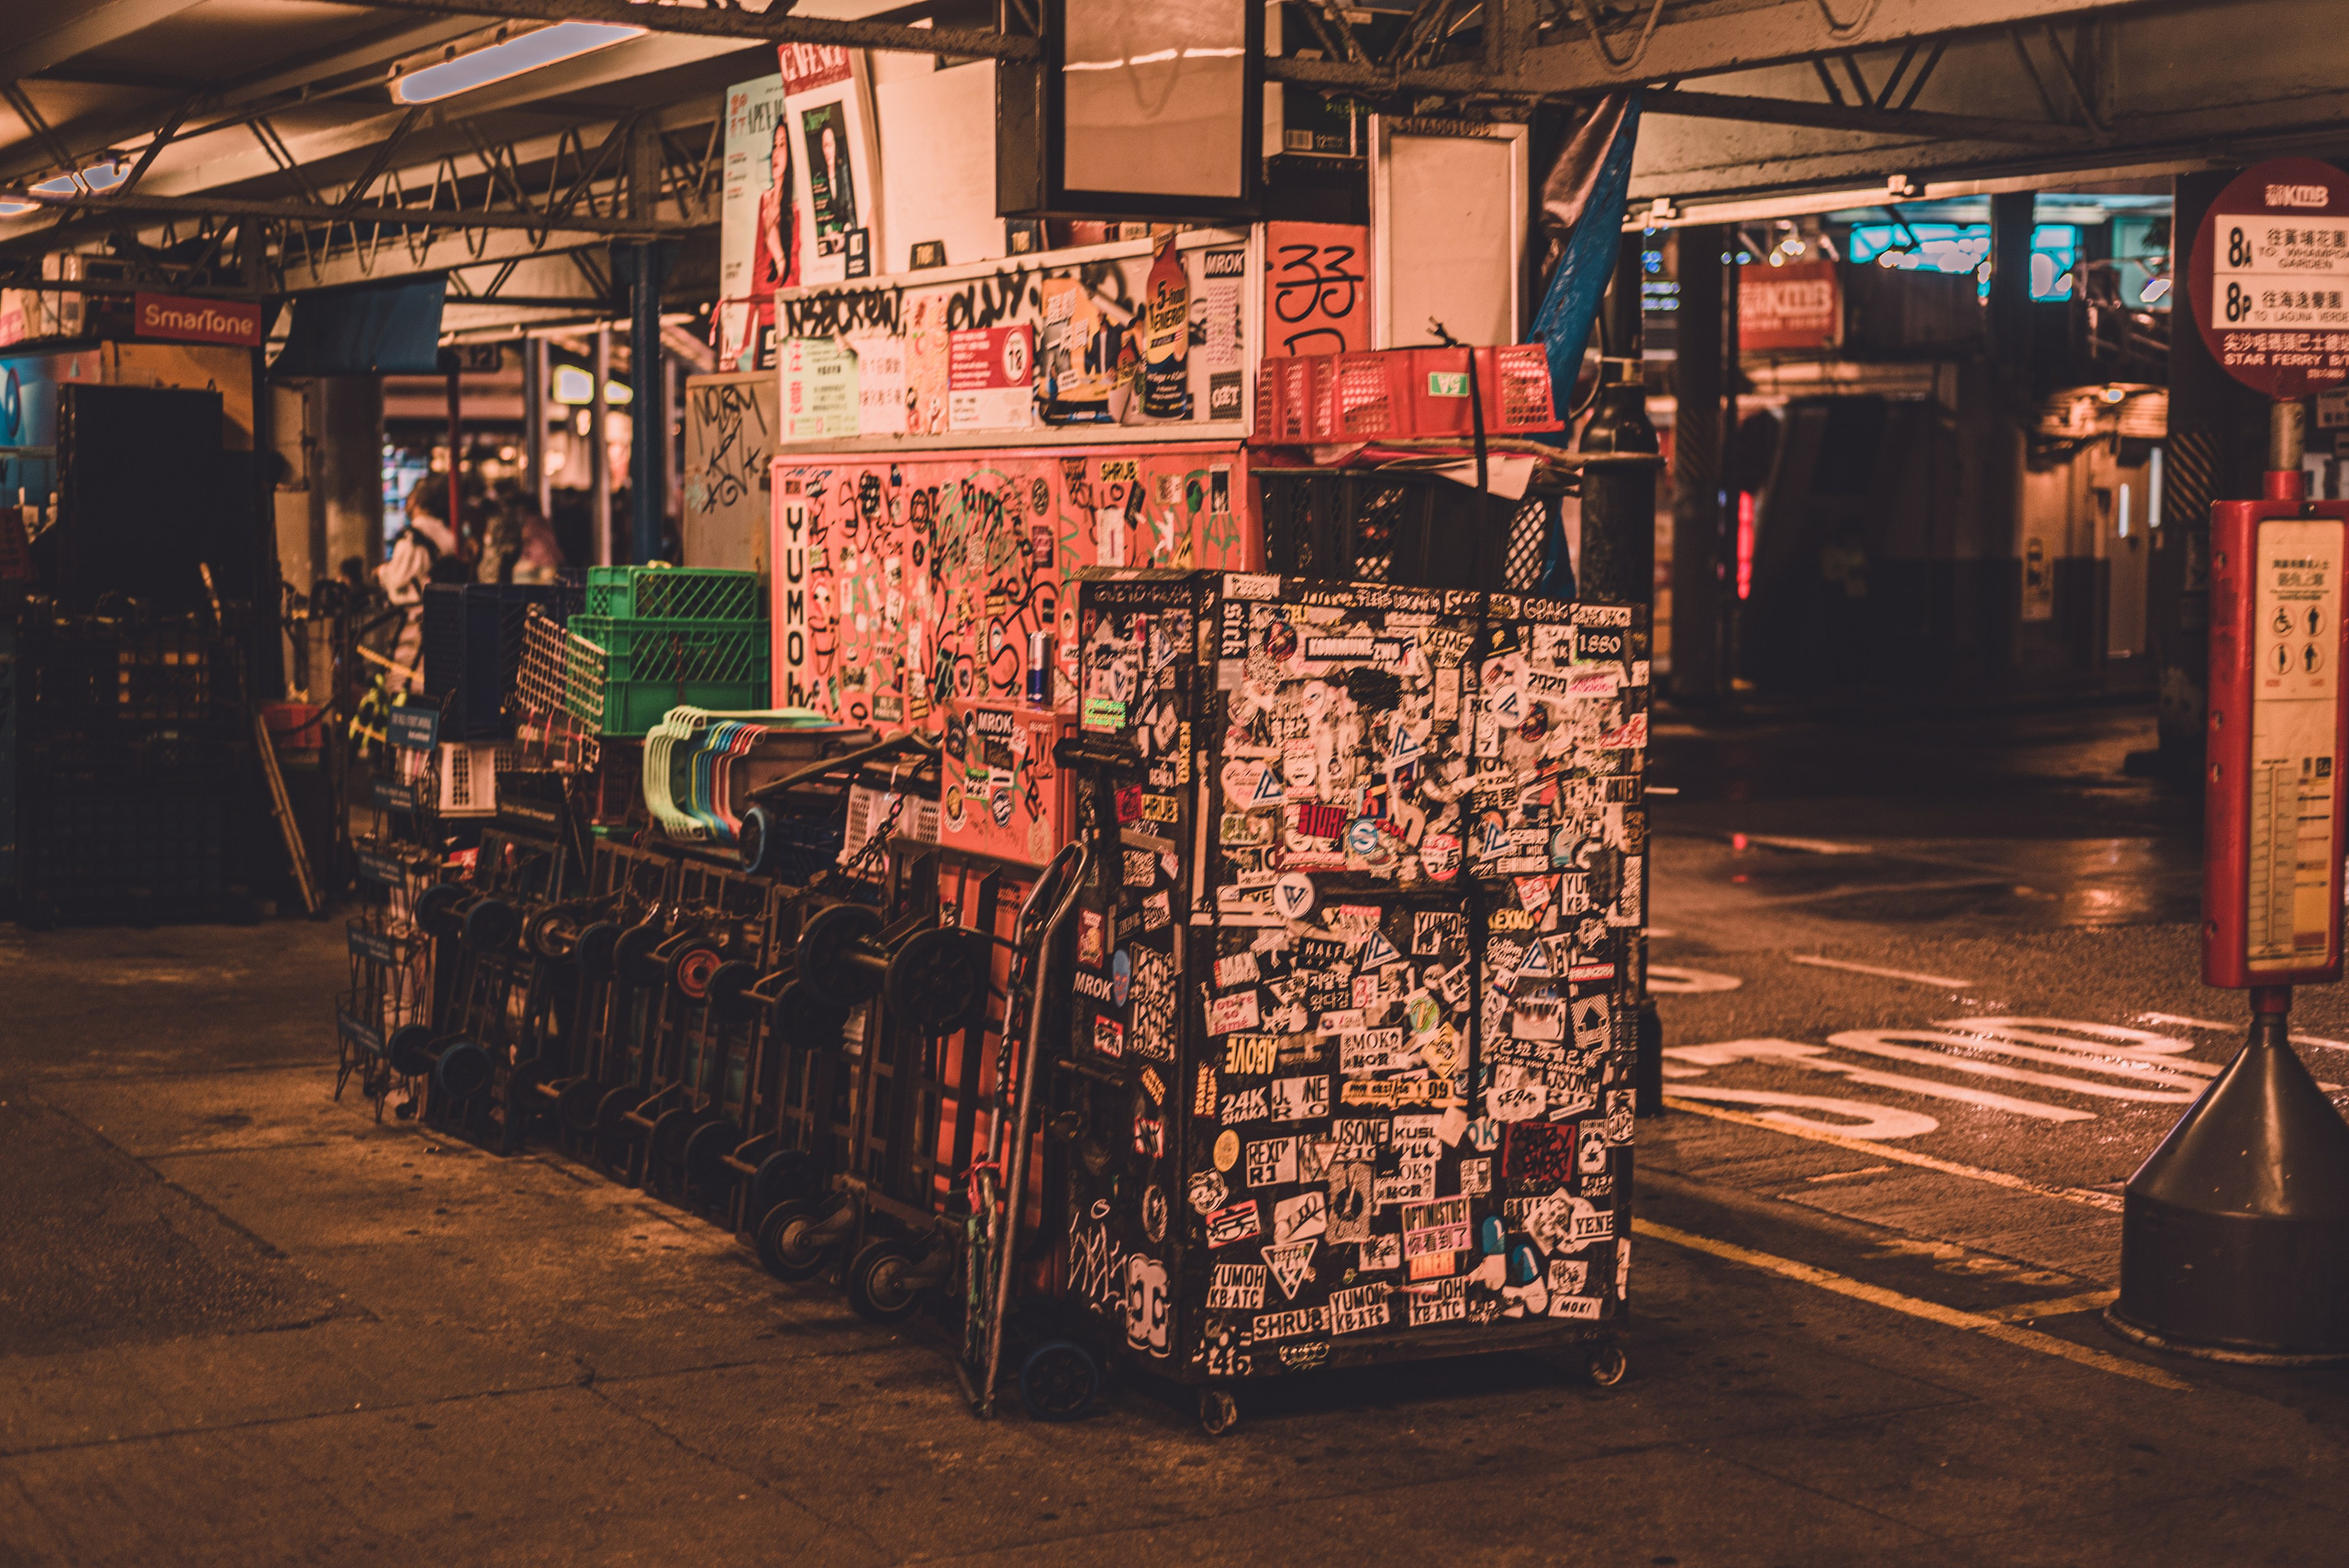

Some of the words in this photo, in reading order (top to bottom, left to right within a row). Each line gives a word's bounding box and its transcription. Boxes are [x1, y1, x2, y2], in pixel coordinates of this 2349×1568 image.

[2229, 227, 2253, 268] 8A
[2226, 282, 2252, 322] 8P
[144, 303, 254, 336] SmarTone
[2224, 353, 2266, 365] STAR
[2271, 354, 2322, 365] FERRY
[1579, 634, 1621, 654] 1880
[977, 711, 1013, 734] MROK
[1073, 972, 1113, 1002] MROK
[1224, 1037, 1279, 1074] ABOVE
[1220, 1086, 1267, 1116] 24K
[1221, 1104, 1269, 1126] SHAKA
[1256, 1308, 1323, 1338] SHRUB
